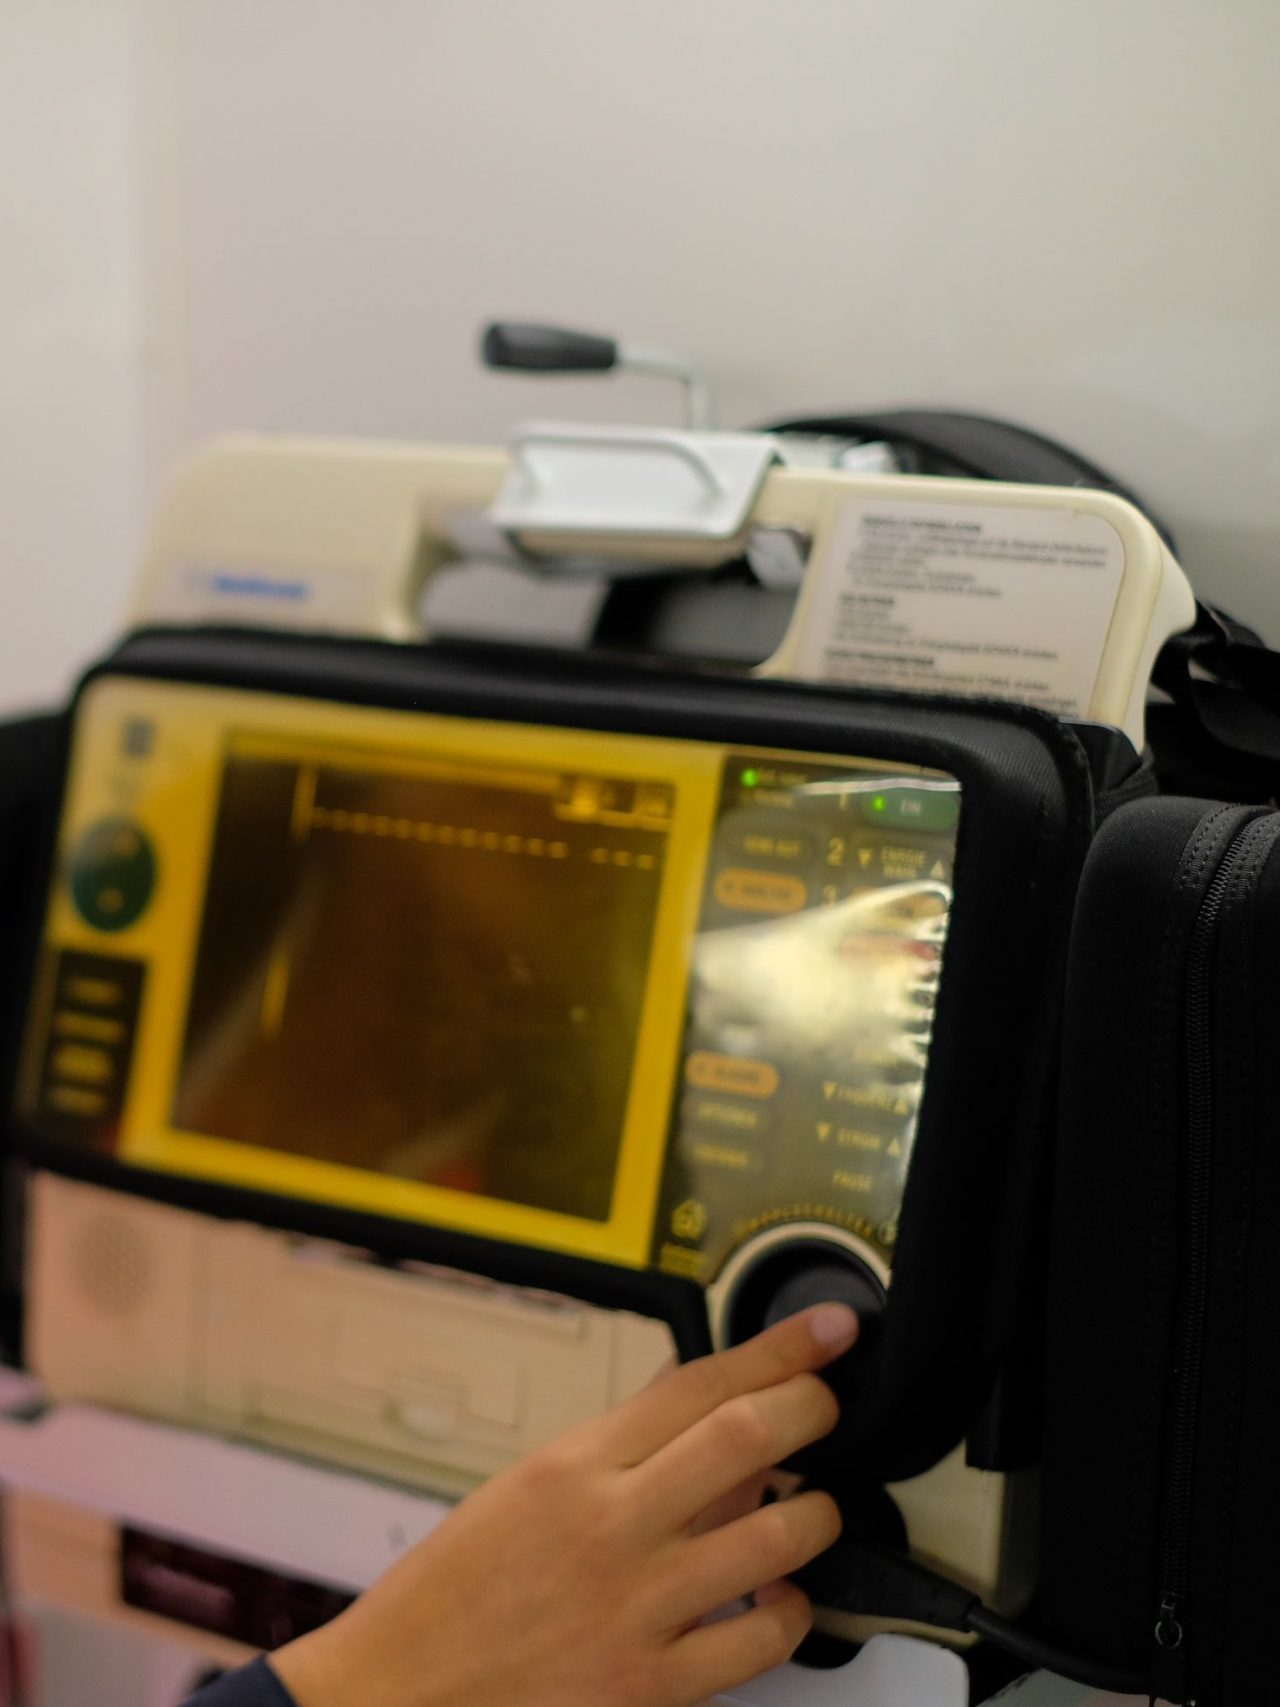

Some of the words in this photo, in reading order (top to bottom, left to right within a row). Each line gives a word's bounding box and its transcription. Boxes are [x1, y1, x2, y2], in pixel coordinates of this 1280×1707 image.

[900, 799, 922, 816] EIN
[828, 837, 845, 866] 2
[833, 1170, 872, 1191] PAUSE
